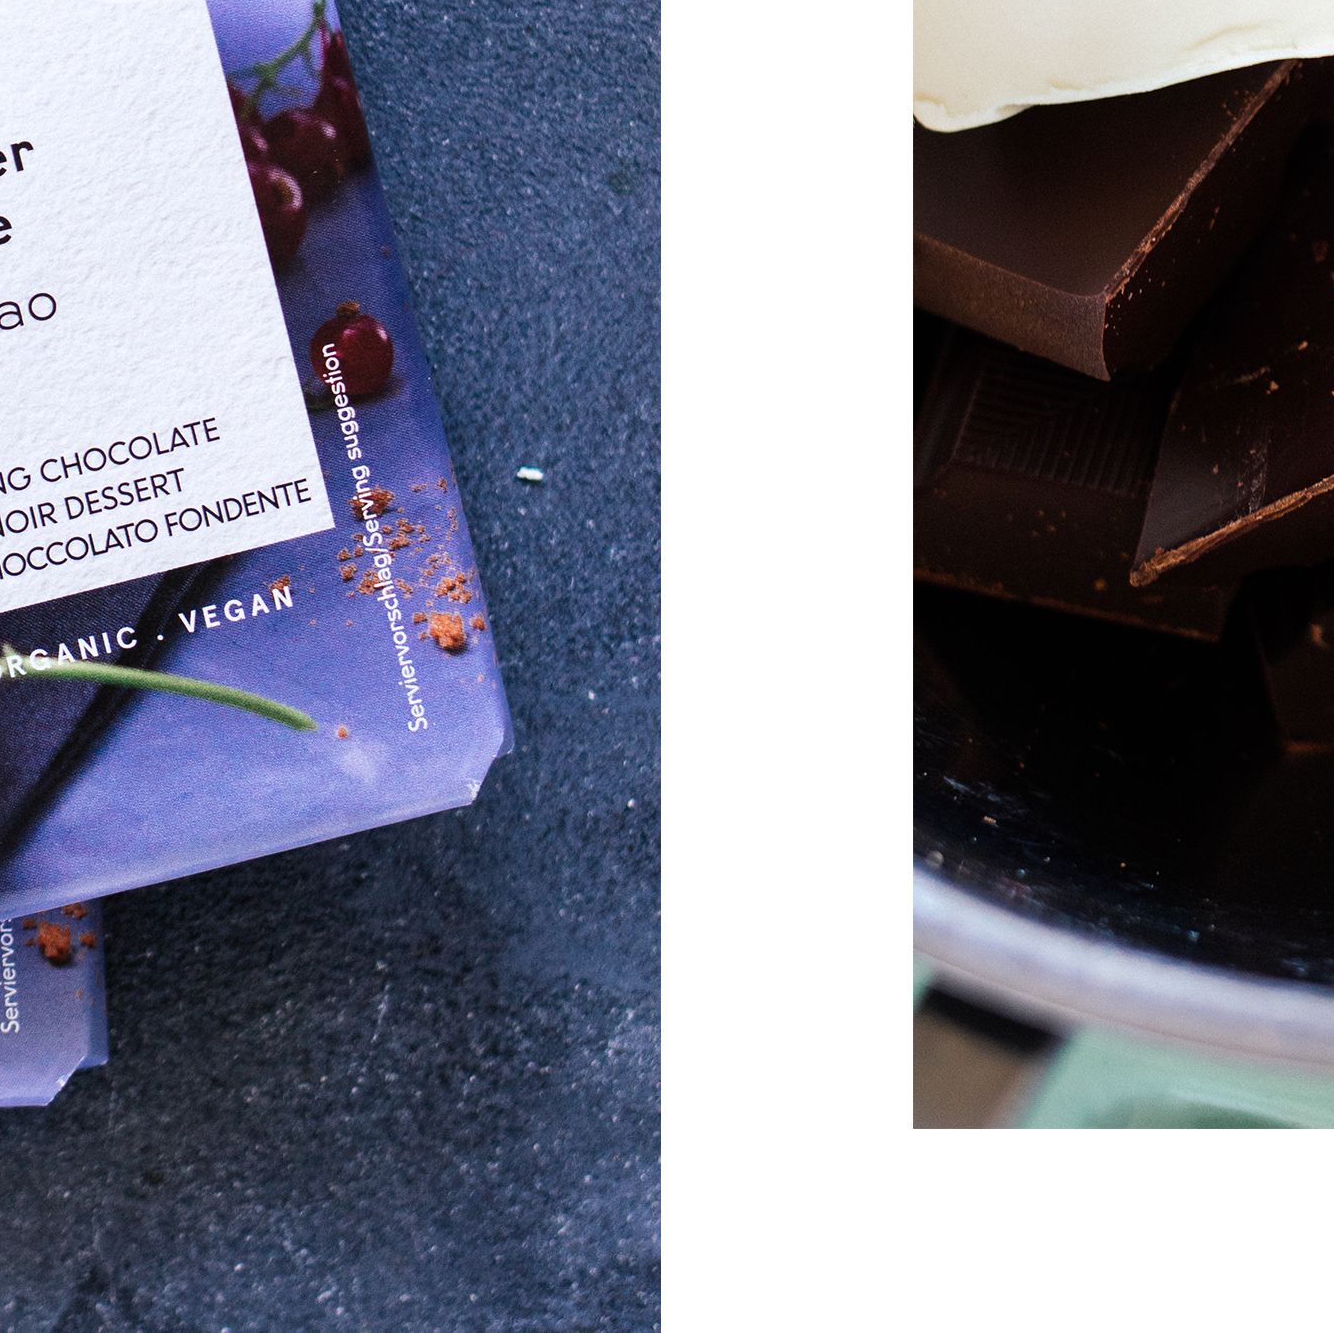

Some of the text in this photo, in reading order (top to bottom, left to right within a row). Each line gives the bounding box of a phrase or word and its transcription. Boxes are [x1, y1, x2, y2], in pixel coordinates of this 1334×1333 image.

[322, 342, 362, 460] suggestion
[41, 418, 220, 482] CHOCOLATE
[65, 468, 184, 519] DESSERT
[165, 479, 311, 536] FONDENTE
[177, 585, 294, 634] VEGAN
